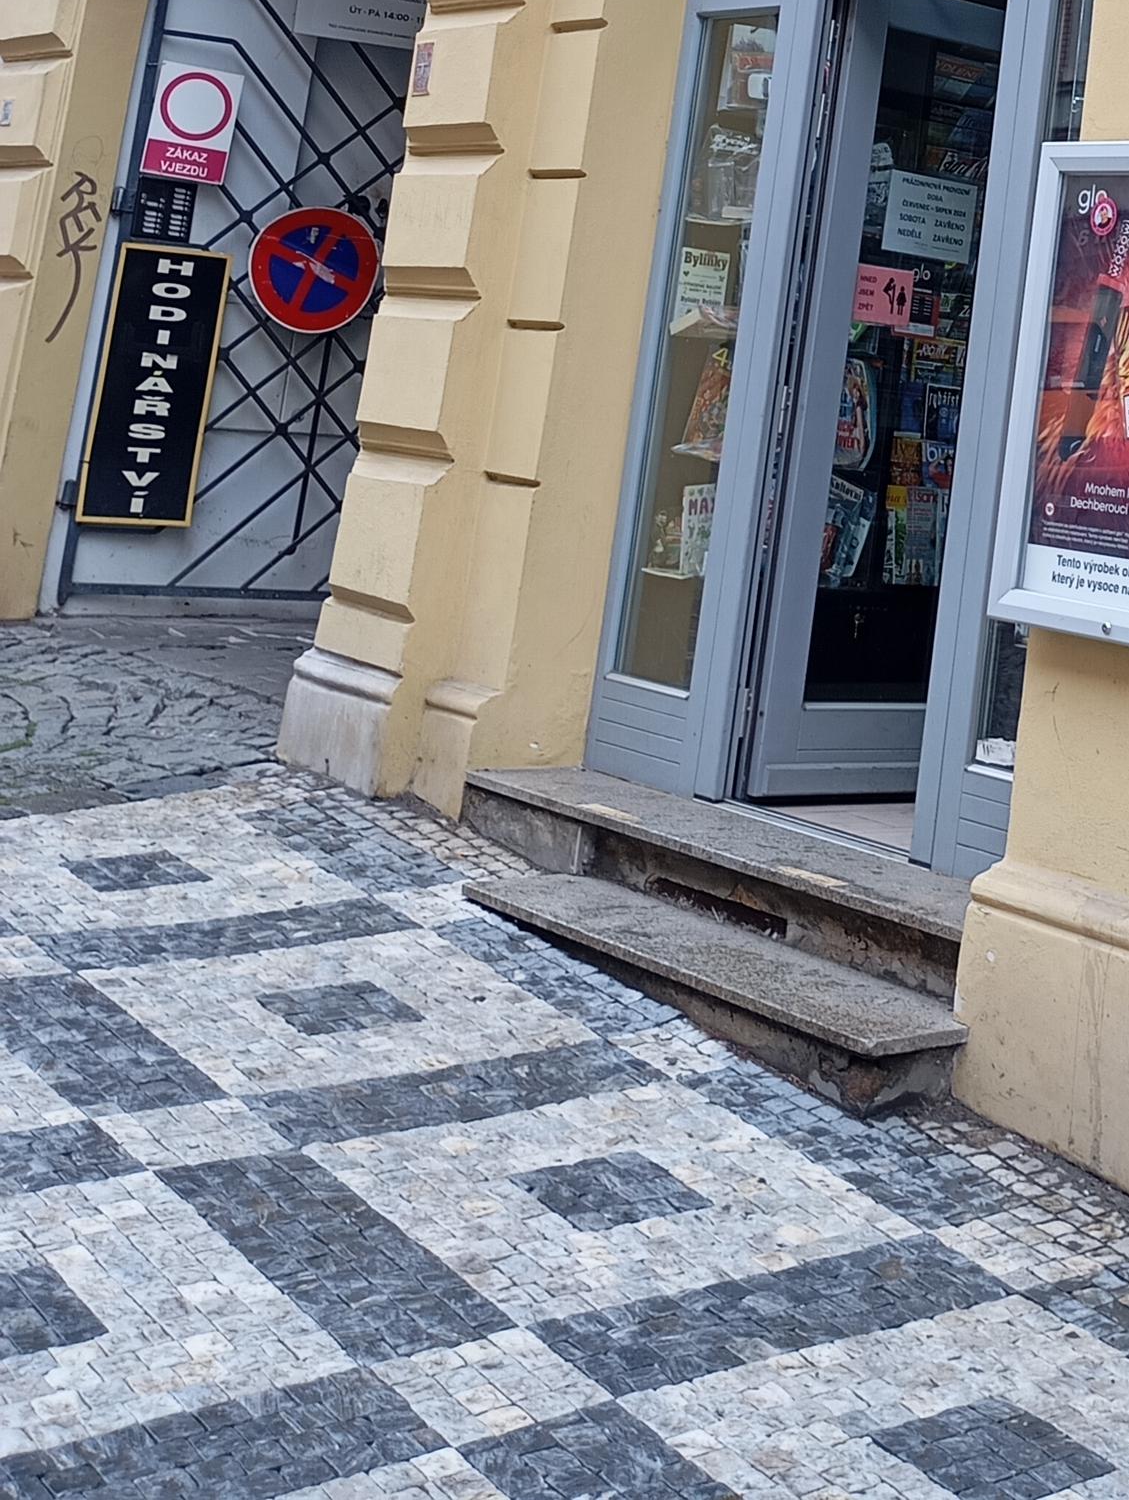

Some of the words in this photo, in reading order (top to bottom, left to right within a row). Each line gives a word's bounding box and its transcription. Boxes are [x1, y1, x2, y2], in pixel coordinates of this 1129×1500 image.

[165, 145, 209, 163] ZÁKAZ
[160, 160, 208, 178] VJEZDU
[121, 257, 195, 514] HODINÁŘSTVÍ
[1084, 482, 1126, 499] Mnohem
[1070, 496, 1129, 517] Dechberoucí
[1056, 554, 1082, 570] Tento
[1083, 560, 1120, 577] výrobek
[1051, 570, 1075, 589] který
[1075, 575, 1085, 590] je
[1086, 579, 1120, 594] vysoce
